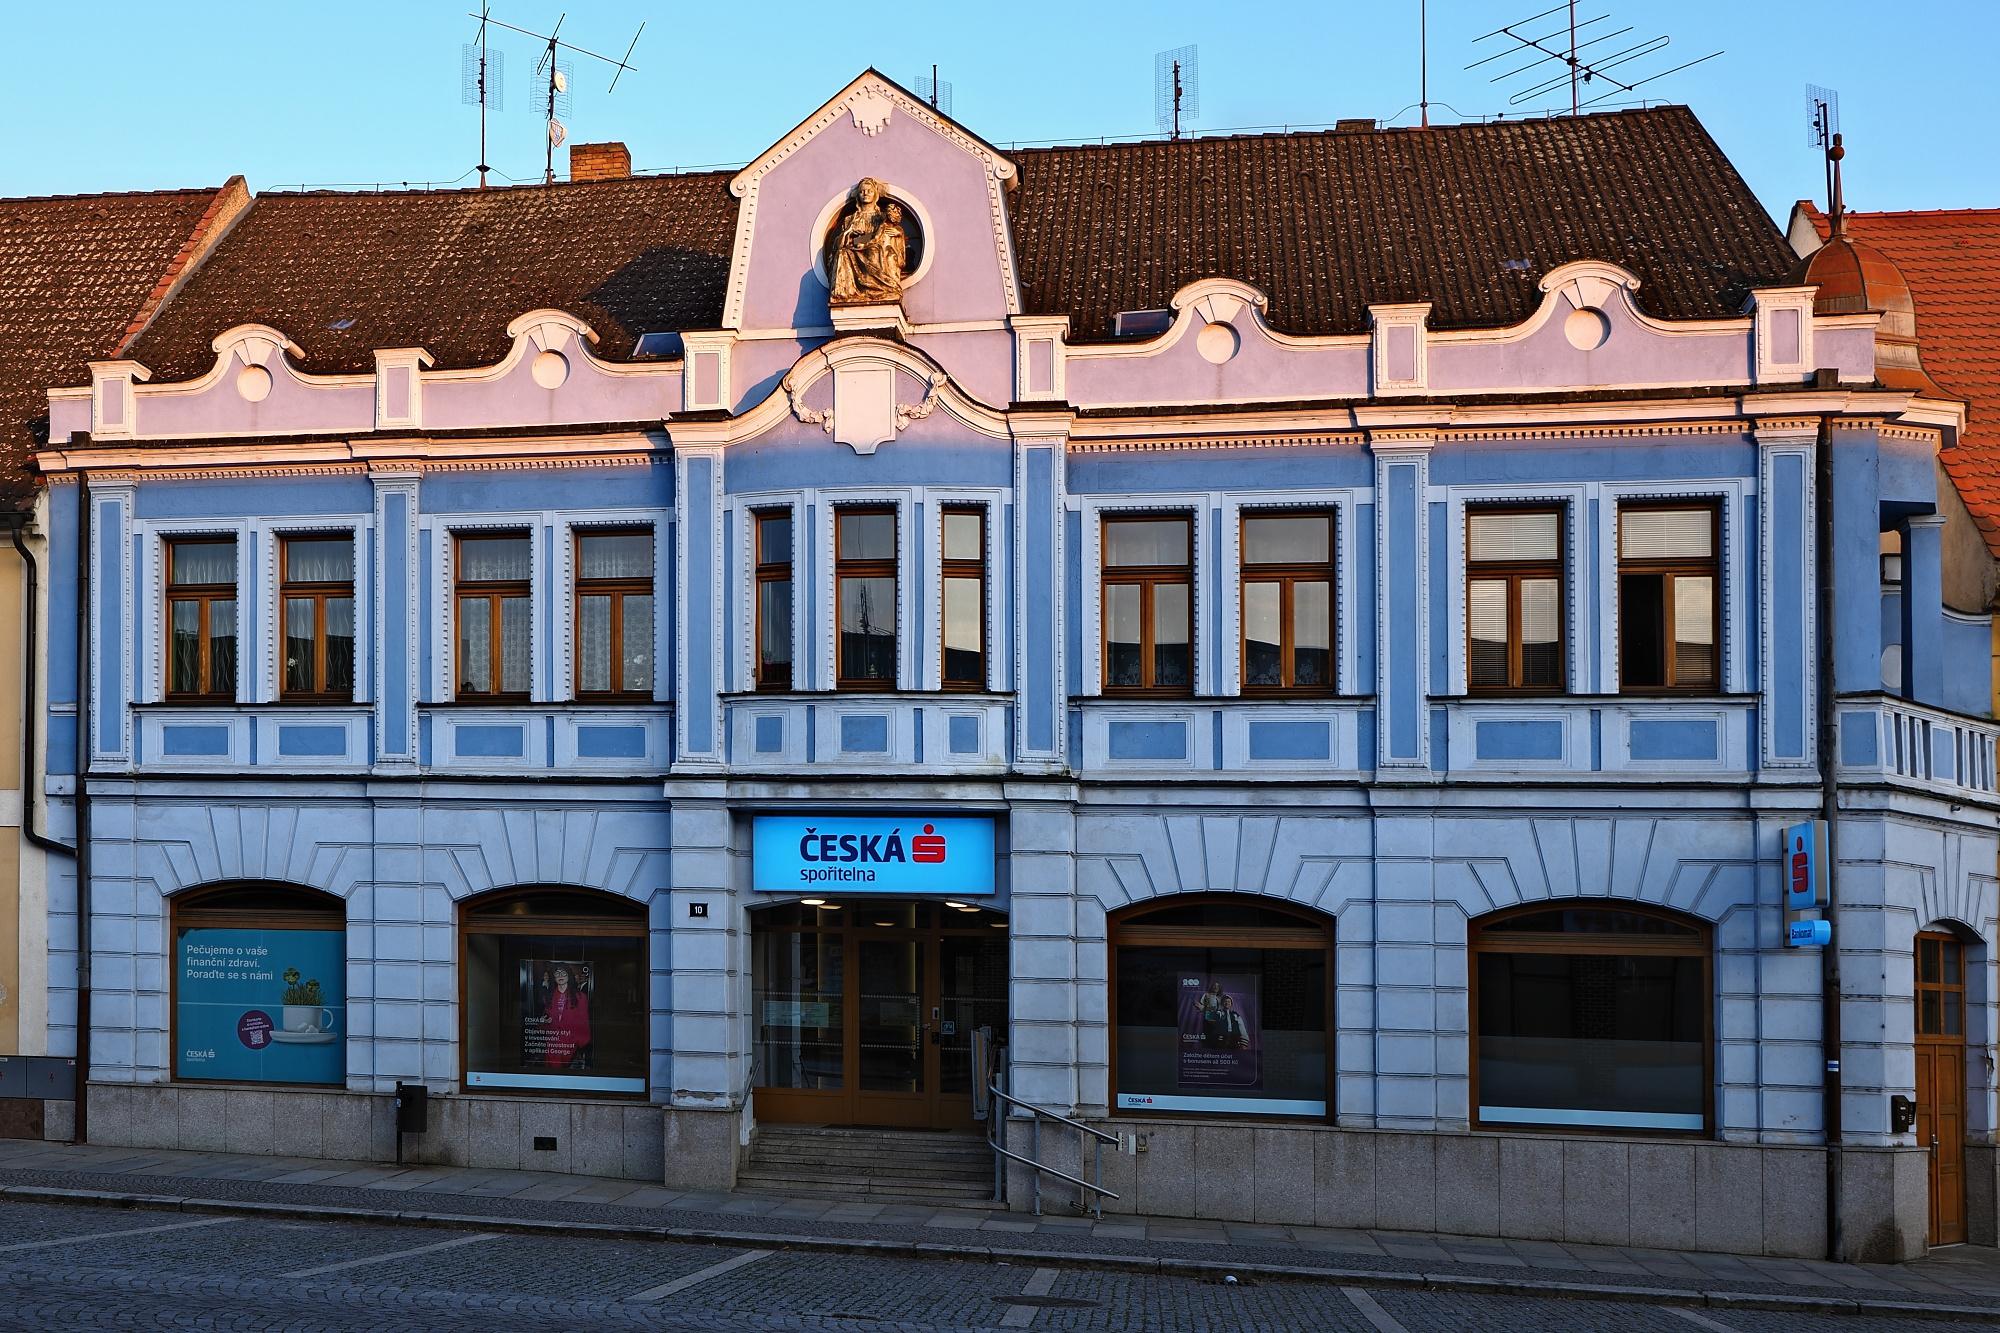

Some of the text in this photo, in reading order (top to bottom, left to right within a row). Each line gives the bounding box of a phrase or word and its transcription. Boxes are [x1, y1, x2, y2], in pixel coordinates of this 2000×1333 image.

[800, 828, 906, 862] ČESKÁ
[801, 866, 875, 883] spořitelna
[695, 906, 702, 914] 10
[187, 945, 234, 956] Pečujeme
[246, 946, 267, 955] vaše
[187, 957, 260, 967] finanční zdraví.
[187, 970, 225, 979] Poraďte
[250, 971, 272, 980] námi
[187, 1049, 207, 1058] ČESKÁ
